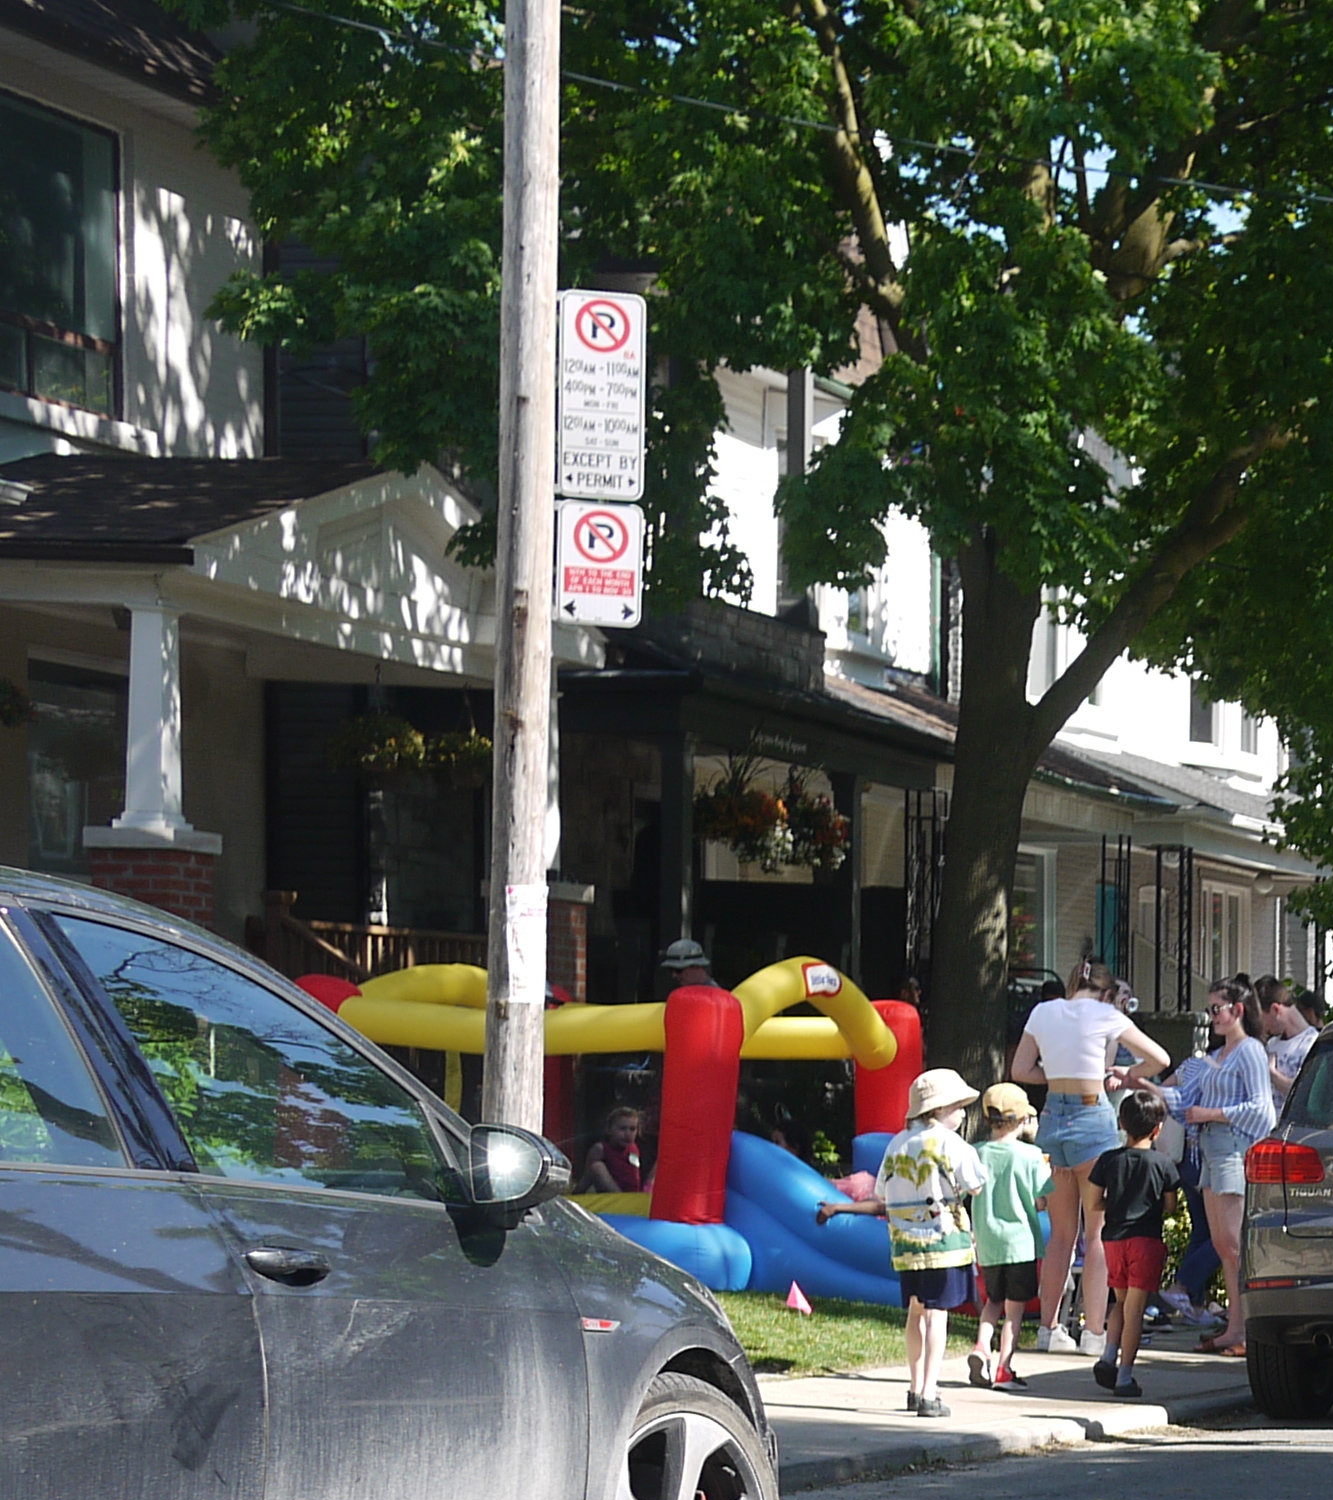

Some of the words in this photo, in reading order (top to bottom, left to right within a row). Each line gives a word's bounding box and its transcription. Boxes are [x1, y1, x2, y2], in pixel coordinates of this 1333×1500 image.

[563, 451, 612, 468] EXCEPT
[619, 455, 638, 470] BY
[577, 471, 623, 489] PERMIT
[605, 577, 630, 586] MONTH
[1289, 1187, 1332, 1198] TIGUAN
